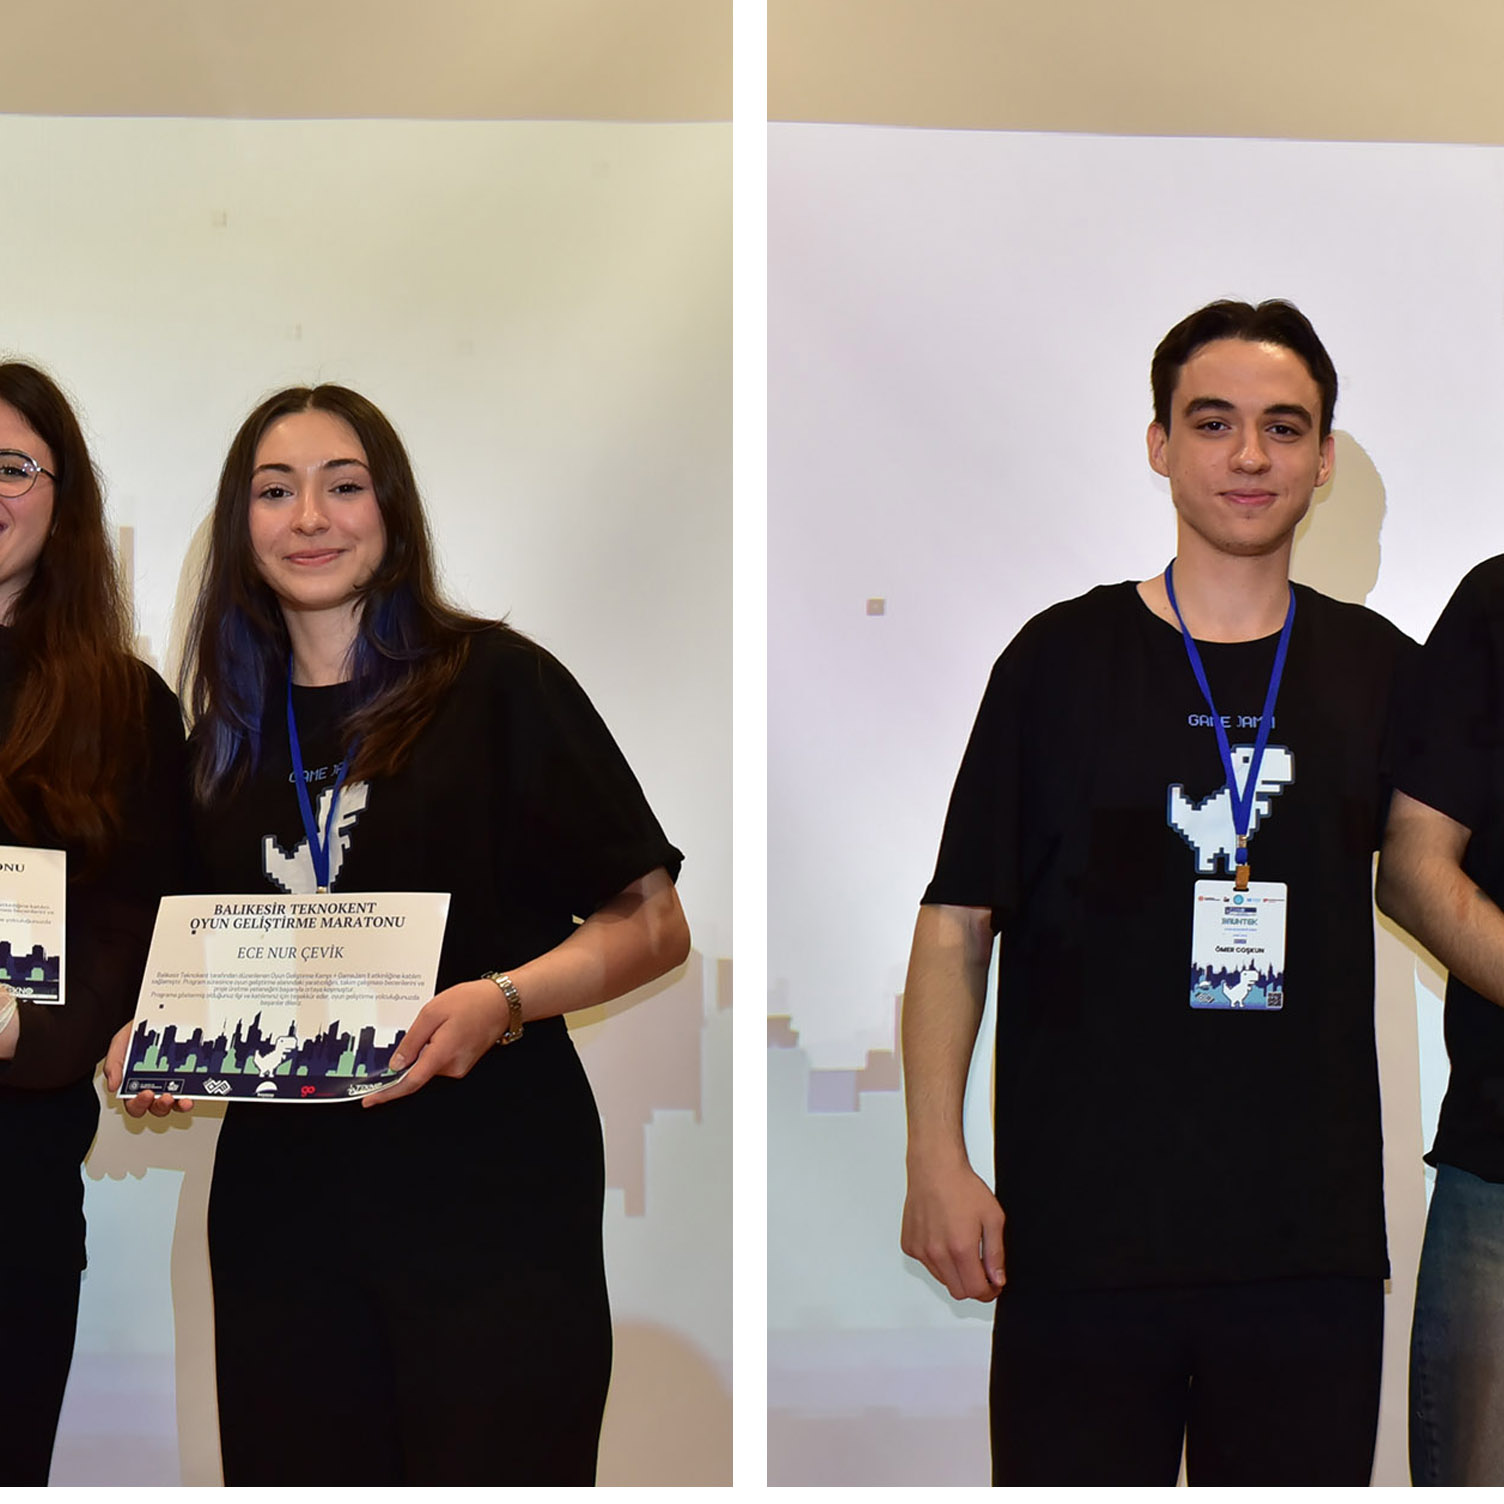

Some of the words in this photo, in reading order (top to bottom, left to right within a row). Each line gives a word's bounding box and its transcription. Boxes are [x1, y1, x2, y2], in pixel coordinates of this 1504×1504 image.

[213, 901, 288, 915] BALIKESİR
[288, 902, 377, 914] TEKNOKENT
[189, 917, 230, 929] OYUN
[231, 914, 318, 931] GELİŞTİRME
[319, 915, 406, 928] MARATONU
[236, 947, 264, 958] ECE
[266, 946, 298, 958] NUR
[299, 944, 346, 961] ÇEVİK
